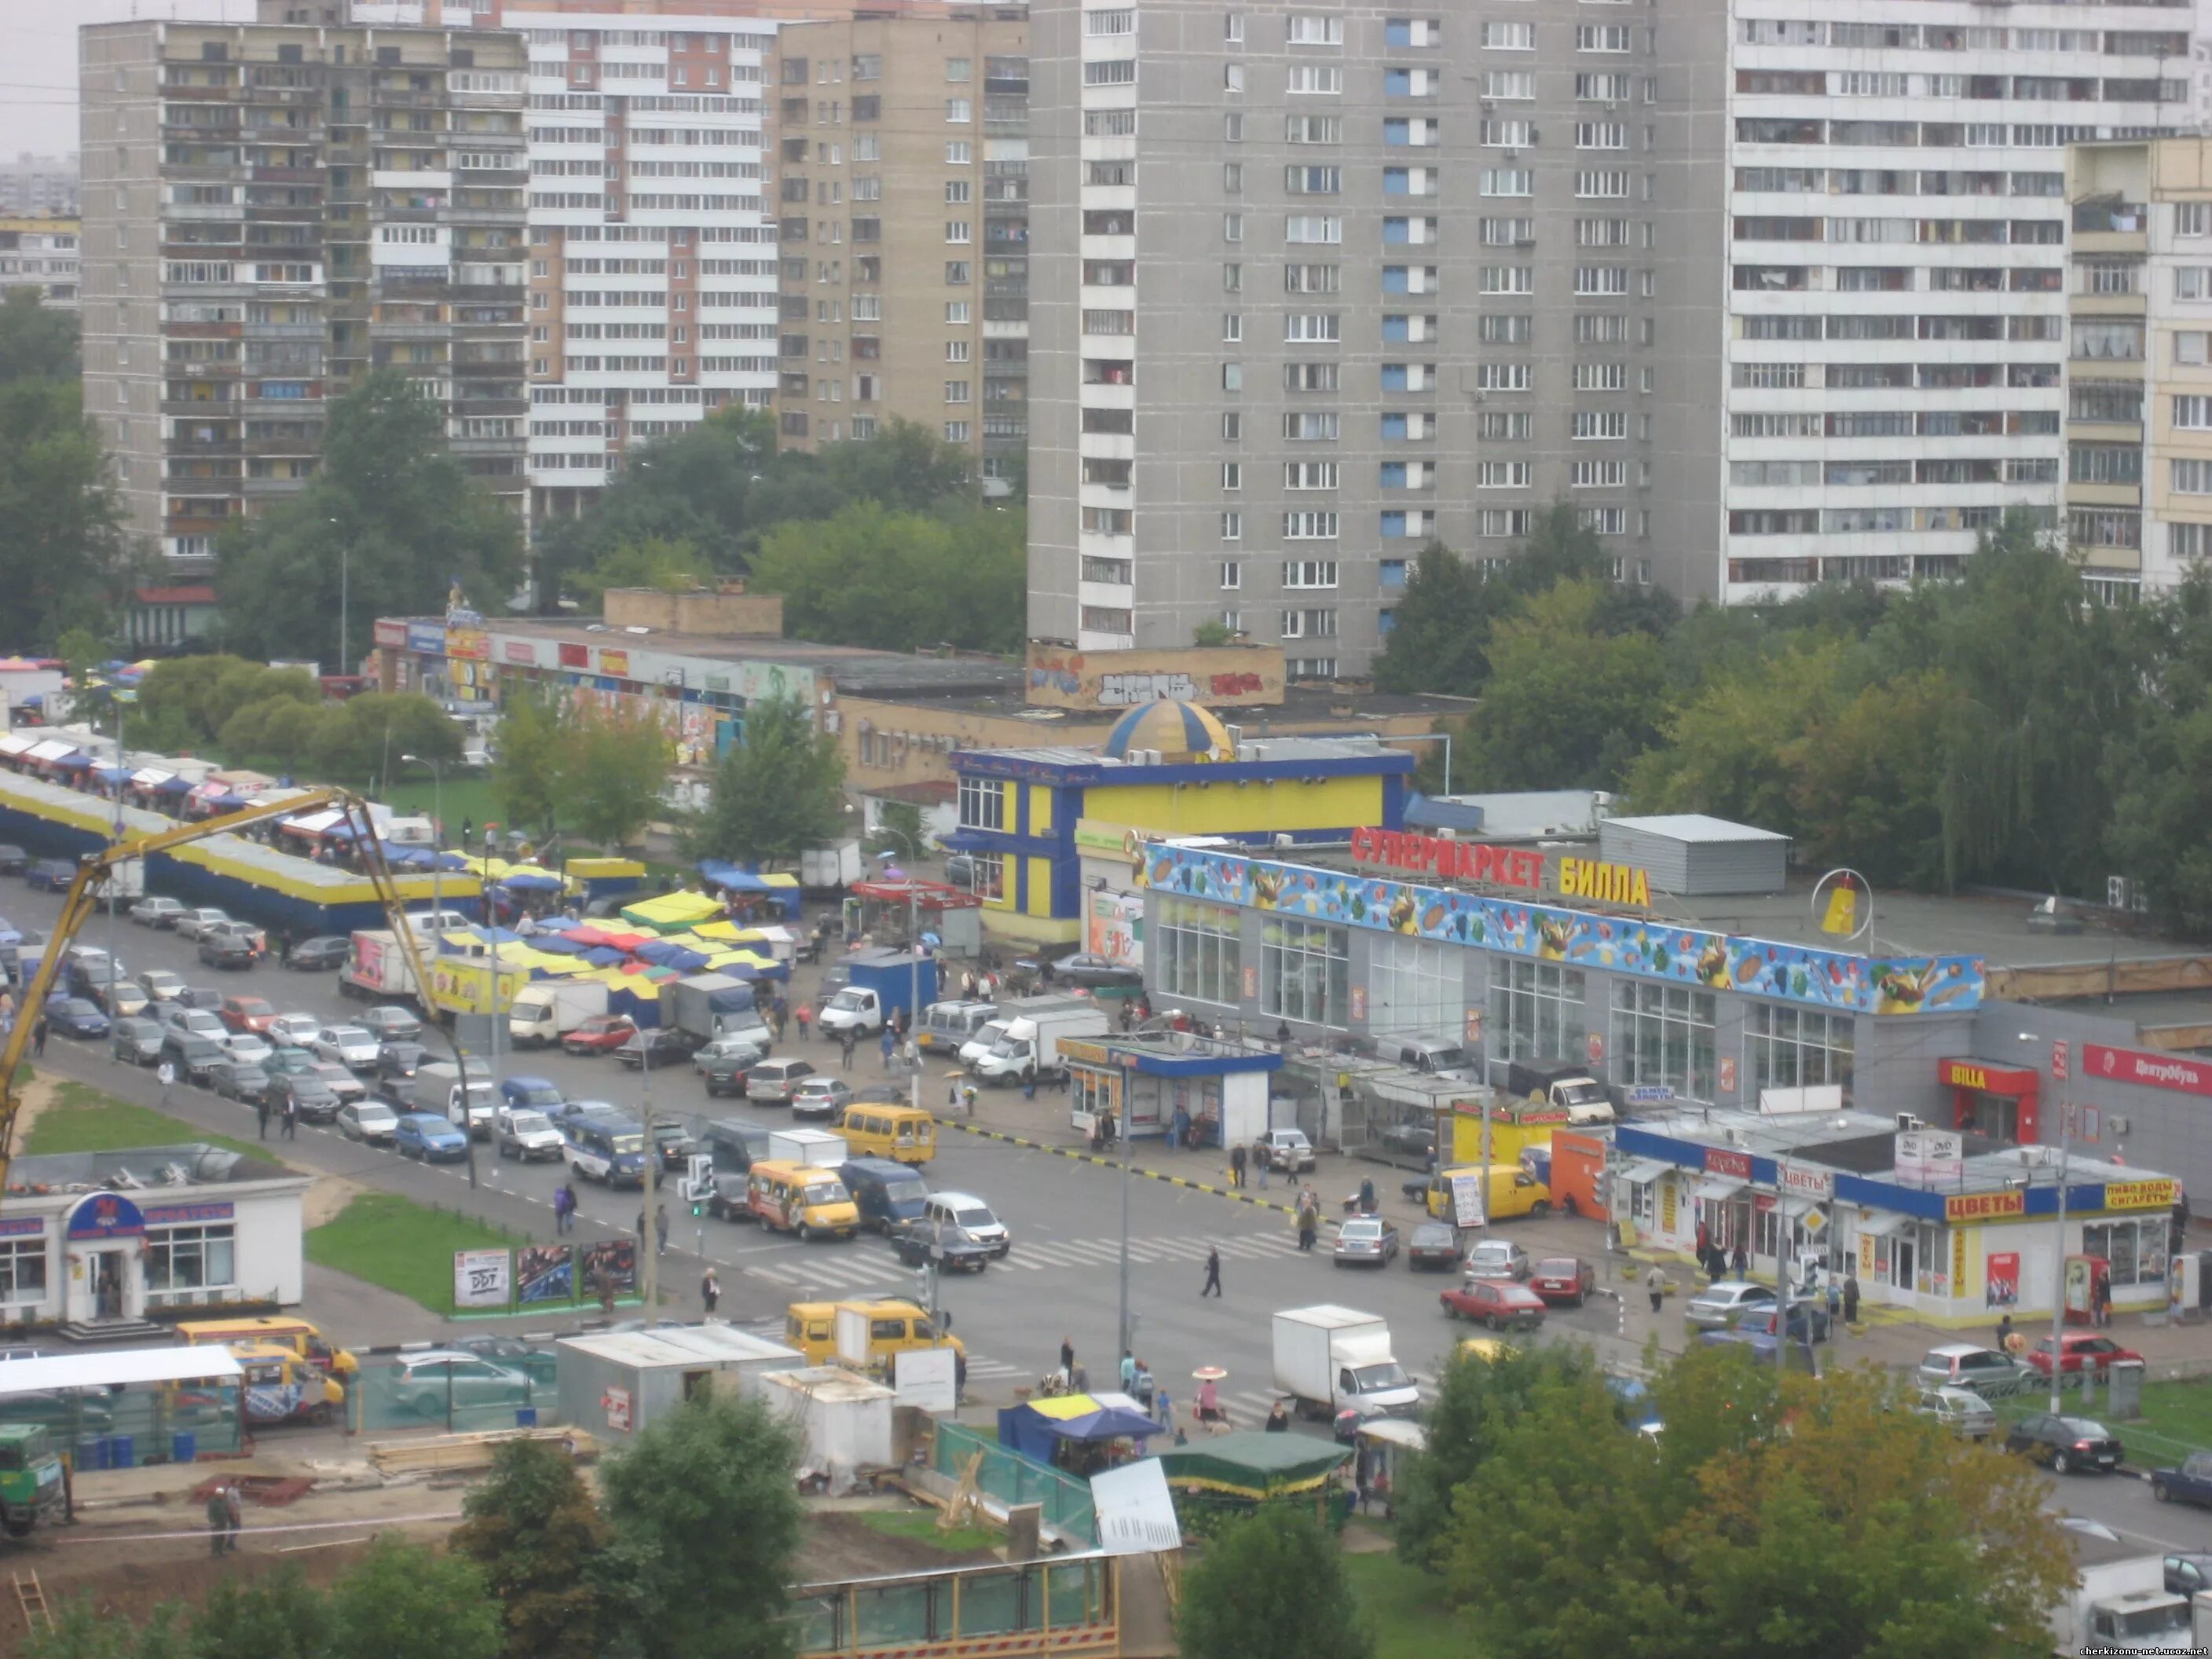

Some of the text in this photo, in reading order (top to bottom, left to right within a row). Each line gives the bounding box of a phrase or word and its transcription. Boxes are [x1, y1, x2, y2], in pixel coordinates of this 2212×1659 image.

[1351, 826, 1651, 907] СУПЕРМАРКЕТ БИЛЛА
[1951, 1066, 1987, 1090] BILLA
[2136, 1059, 2199, 1085] ЦентрОбувь
[1785, 1170, 1824, 1191] ЦВЕТЫ
[1949, 1192, 2023, 1218] ЦВЕТЫ
[2111, 1192, 2169, 1206] СИГАРЕТЫ
